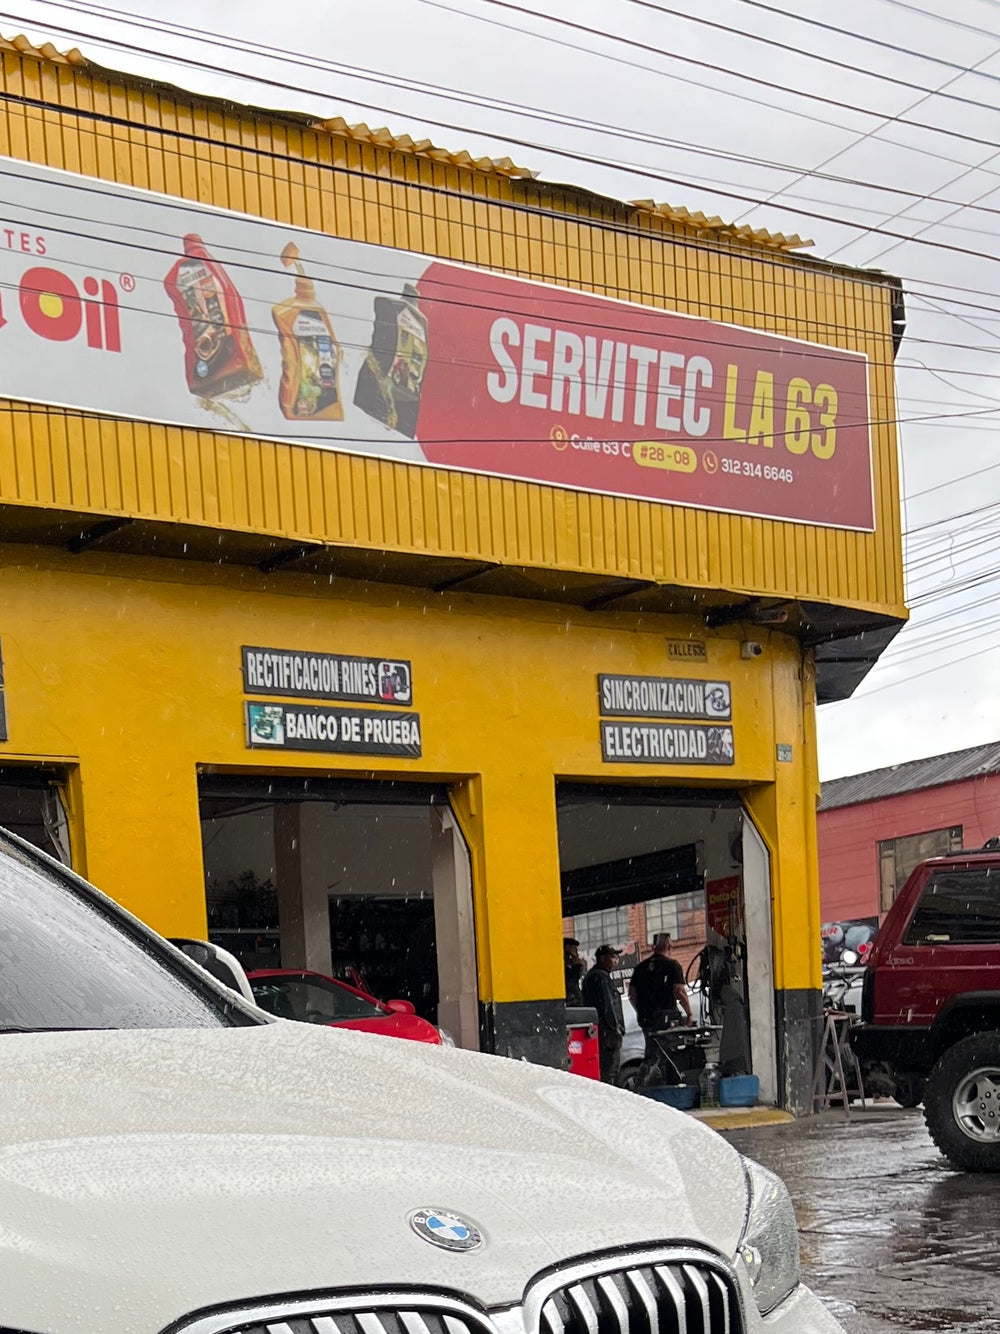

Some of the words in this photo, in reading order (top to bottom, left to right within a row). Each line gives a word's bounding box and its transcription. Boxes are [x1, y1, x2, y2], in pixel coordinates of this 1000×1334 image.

[486, 317, 713, 437] SERVITEC
[723, 364, 774, 451] LA
[785, 377, 839, 460] 63
[602, 440, 620, 455] 63
[621, 442, 631, 457] C
[721, 458, 741, 474] 312
[742, 462, 762, 477] 314
[763, 465, 793, 483] 6646
[247, 652, 339, 693] RECTIFICACION
[341, 661, 377, 696] RINES
[603, 679, 704, 714] SINCRONIZACION
[286, 713, 338, 741] BANCO
[341, 716, 361, 742] DE
[363, 718, 421, 745] PRUEBA
[605, 726, 707, 758] ELECTRICIDAD
